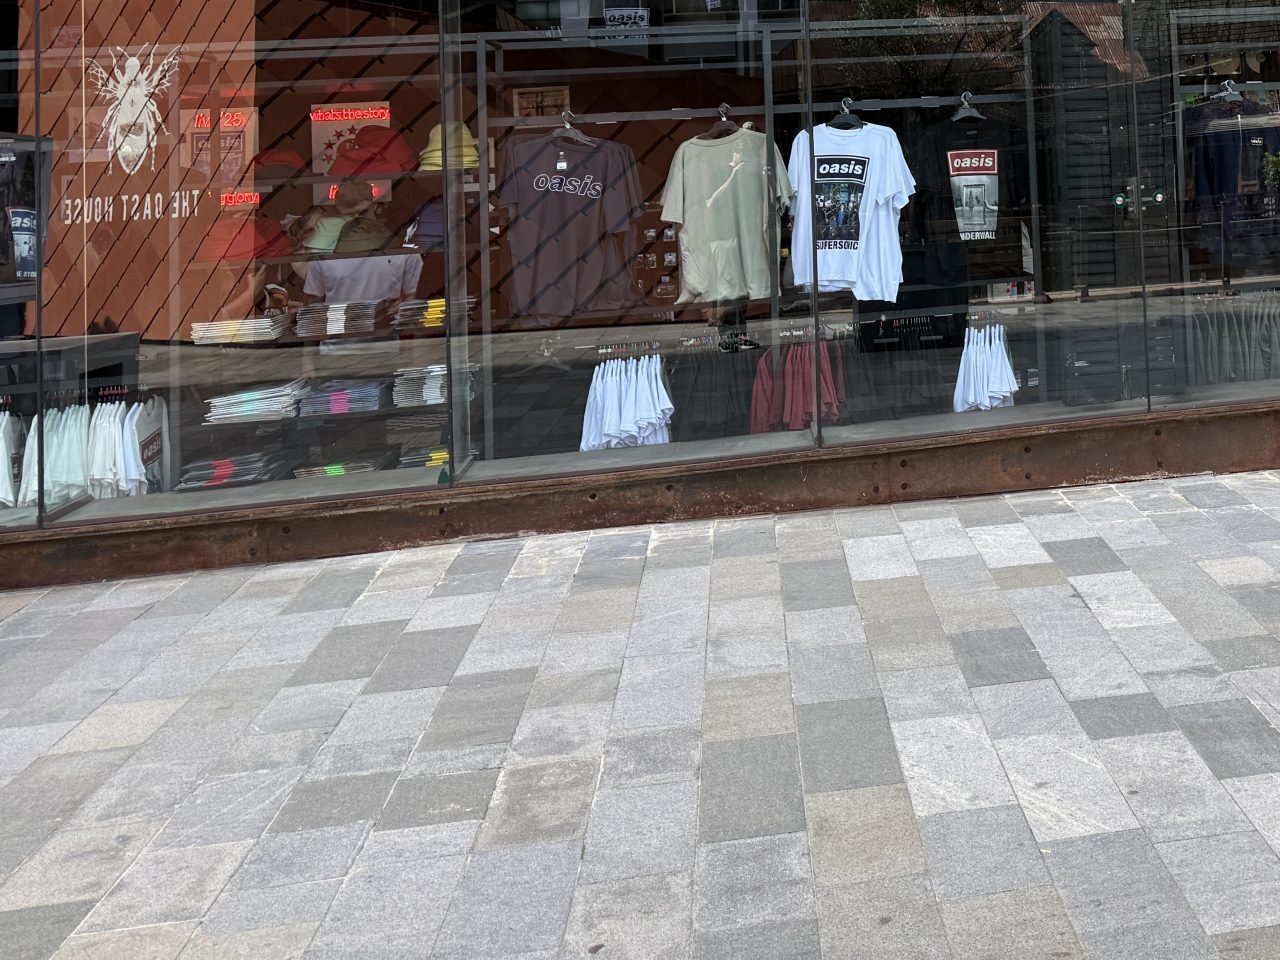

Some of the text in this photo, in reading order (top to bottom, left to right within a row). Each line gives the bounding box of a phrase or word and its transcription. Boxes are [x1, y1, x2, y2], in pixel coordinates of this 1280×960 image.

[608, 11, 645, 23] oasis
[198, 136, 240, 148] osis
[819, 161, 863, 175] oasis
[953, 155, 993, 168] oasis
[533, 173, 603, 198] oasis
